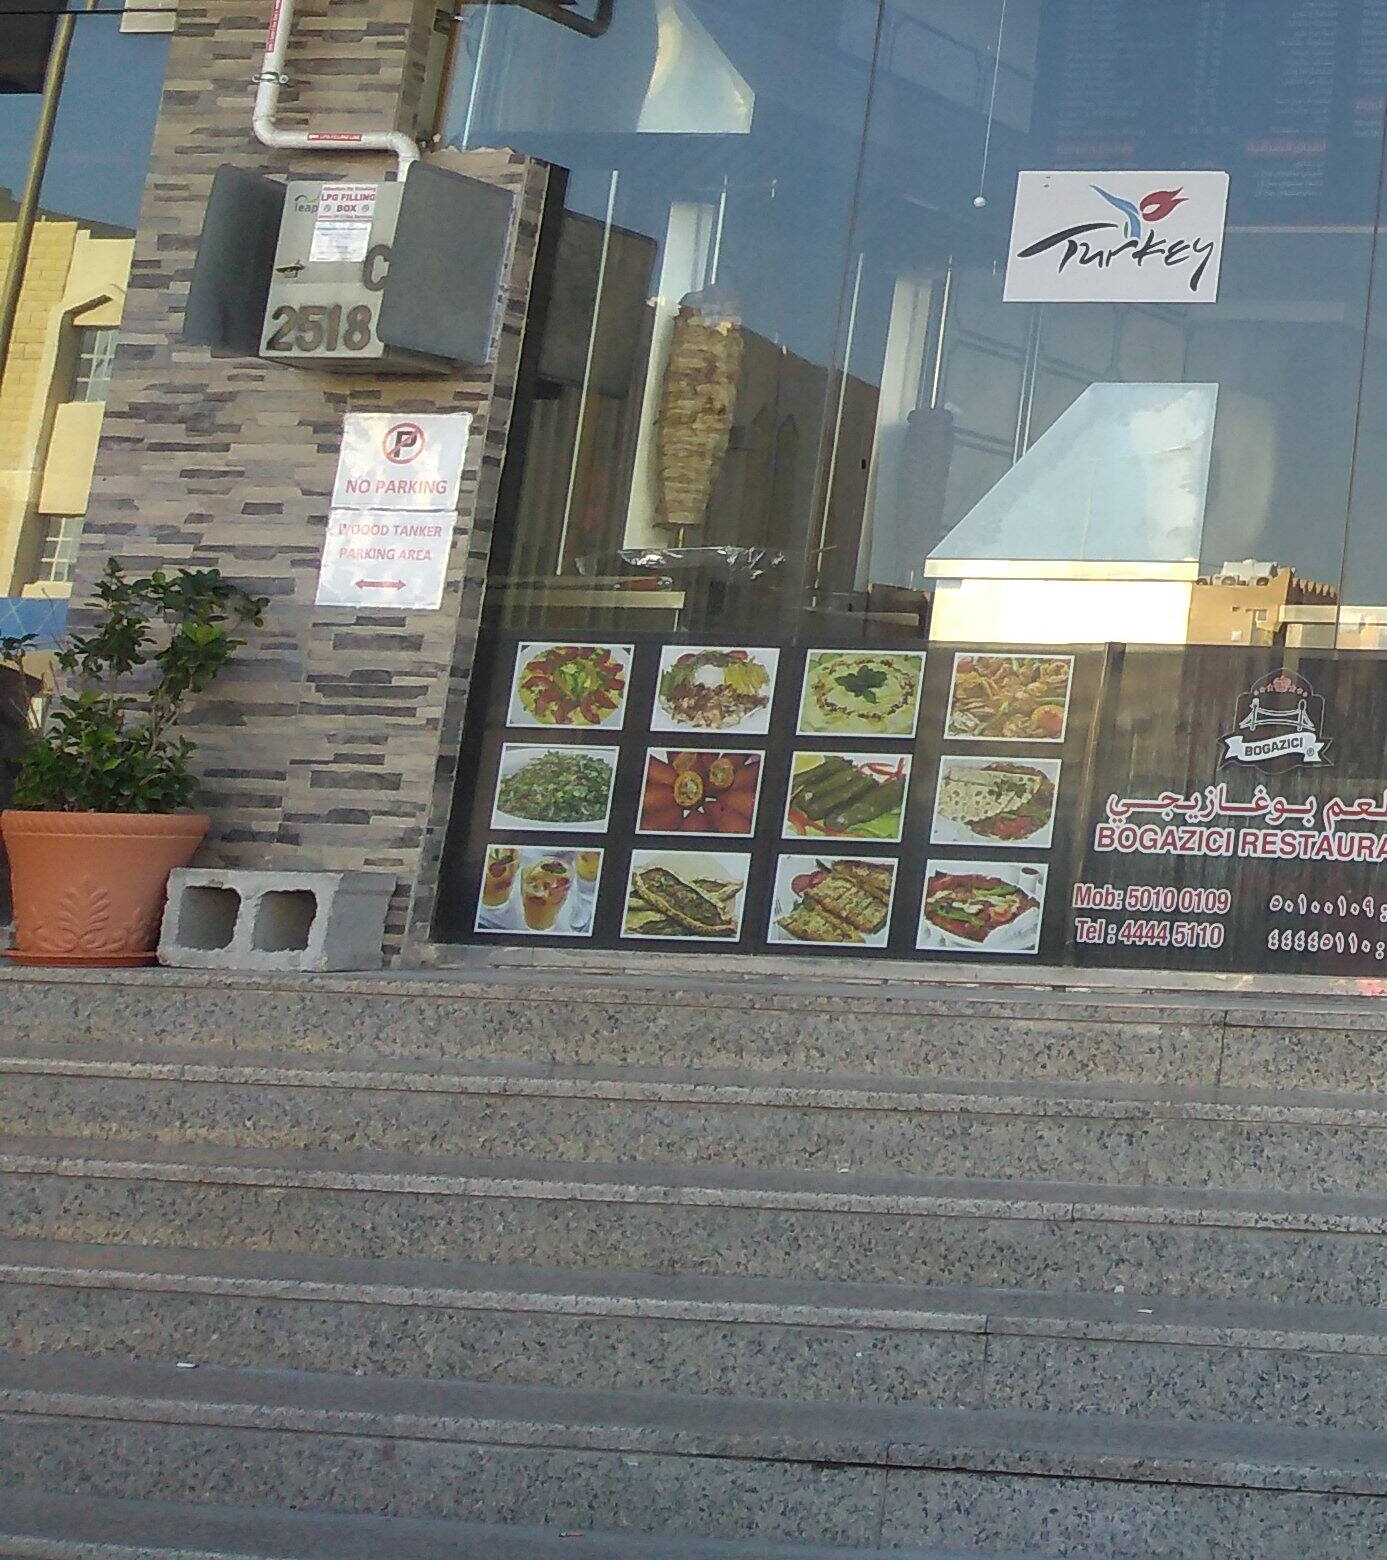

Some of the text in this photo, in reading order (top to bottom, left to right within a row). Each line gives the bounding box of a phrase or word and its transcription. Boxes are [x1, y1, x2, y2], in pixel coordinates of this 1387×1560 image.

[1016, 222, 1215, 292] Turkey
[265, 303, 373, 352] 2518
[345, 479, 448, 495] NO PARKING
[393, 525, 442, 538] TANKER
[339, 548, 433, 562] PARKING AREA
[1244, 737, 1304, 758] BOGAZICI
[1105, 783, 1317, 827] بوغازيجي
[1093, 823, 1234, 854] BOGAZICI
[1126, 885, 1180, 912] 5010
[1178, 886, 1231, 915] 0109
[1119, 920, 1171, 946] 4444
[1172, 921, 1225, 949] 5110
